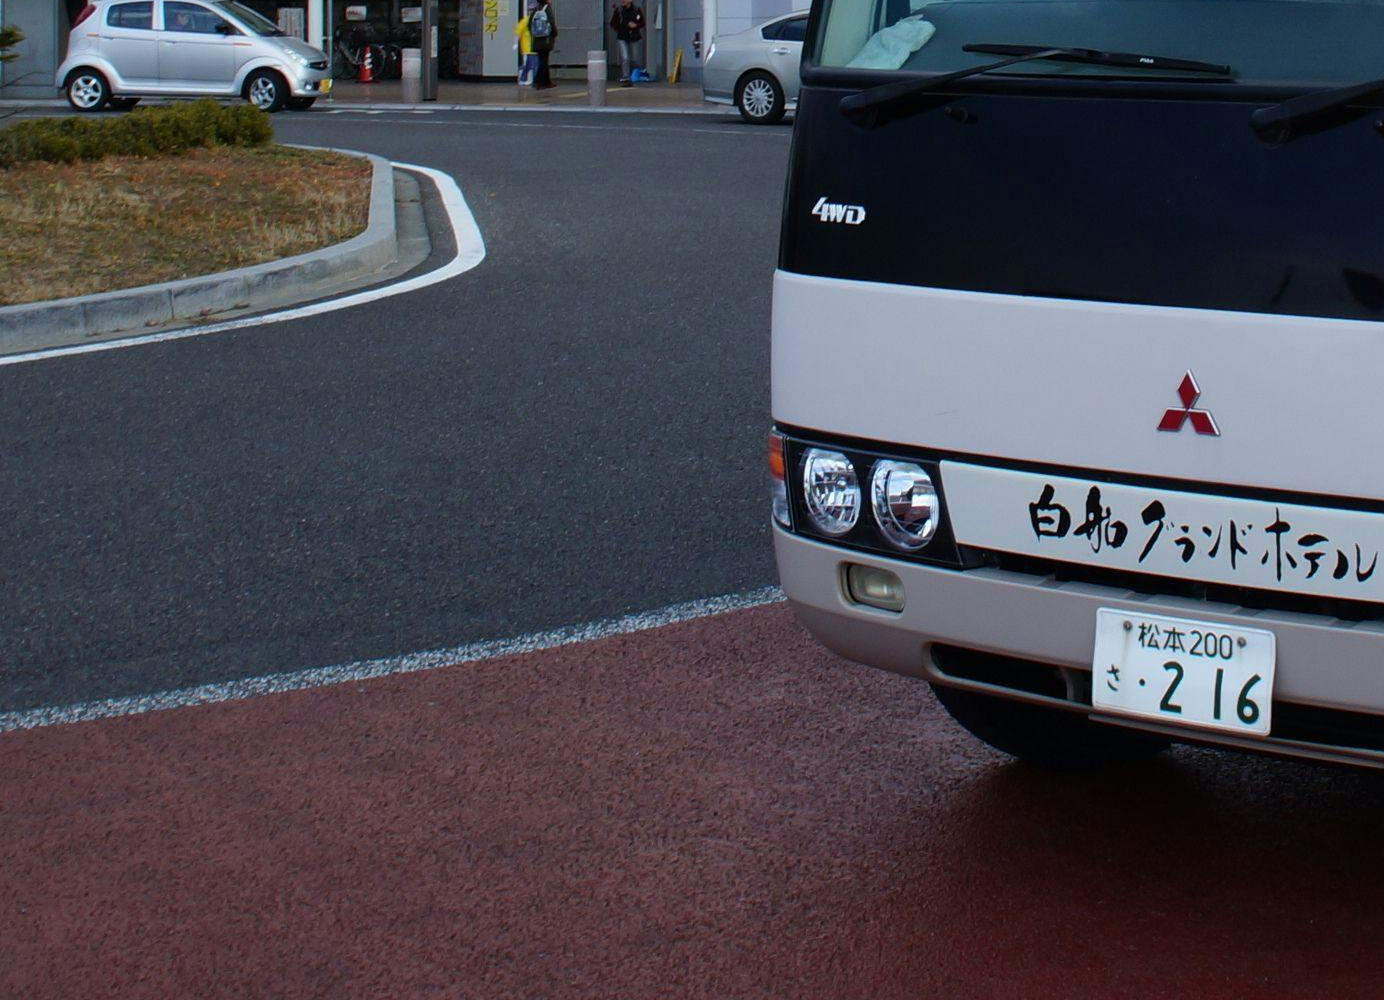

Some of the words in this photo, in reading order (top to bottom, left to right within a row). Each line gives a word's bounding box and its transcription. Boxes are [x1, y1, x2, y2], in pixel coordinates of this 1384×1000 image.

[811, 196, 866, 225] 4WD
[1028, 483, 1379, 582] 白船グランドホテル
